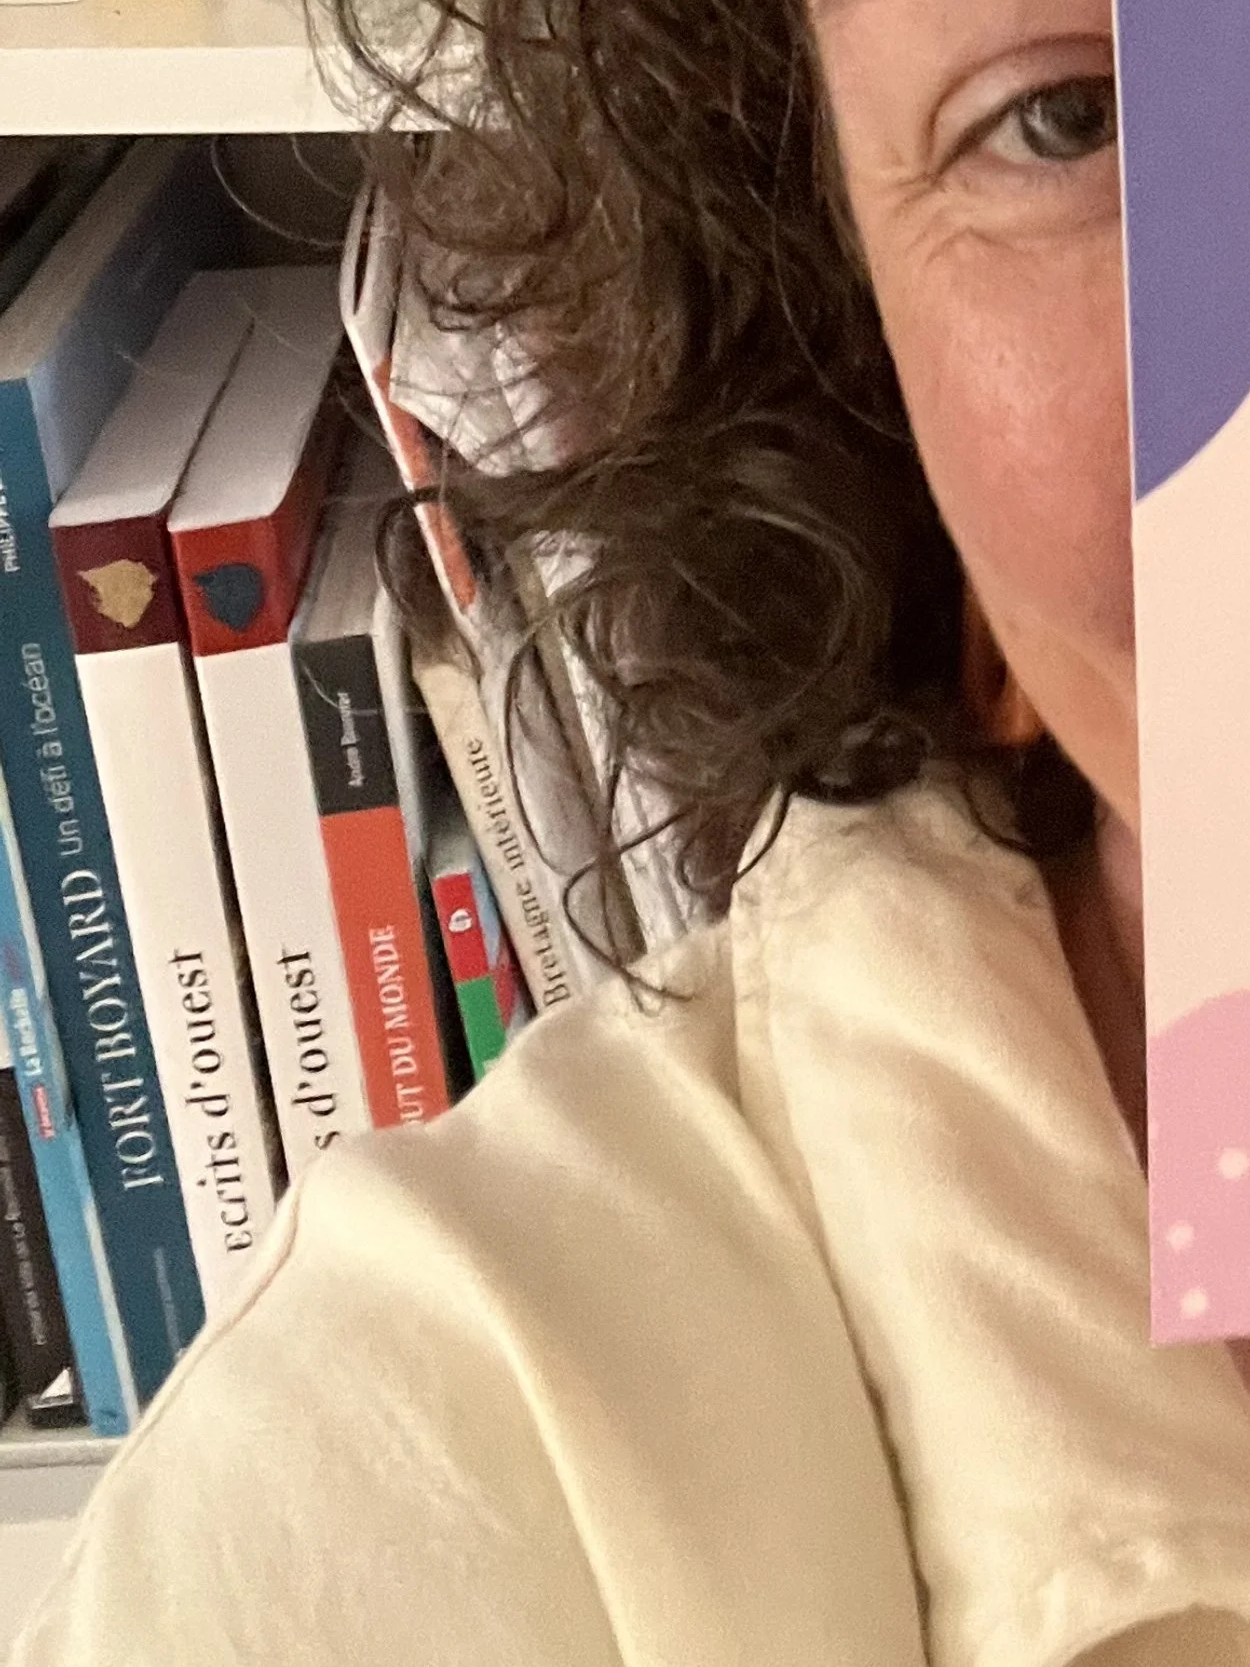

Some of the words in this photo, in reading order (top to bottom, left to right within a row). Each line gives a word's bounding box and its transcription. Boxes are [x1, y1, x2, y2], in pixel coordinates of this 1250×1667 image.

[57, 818, 84, 857] Un
[467, 736, 525, 871] intérieure
[60, 868, 137, 1064] BOYARD
[369, 924, 411, 1031] MONDE
[516, 881, 571, 1007] Bretagne
[168, 947, 231, 1118] d'ouest
[277, 943, 338, 1117] d'ouest
[386, 1037, 418, 1077] DU
[101, 1072, 165, 1191] FORT
[396, 1083, 424, 1123] UT
